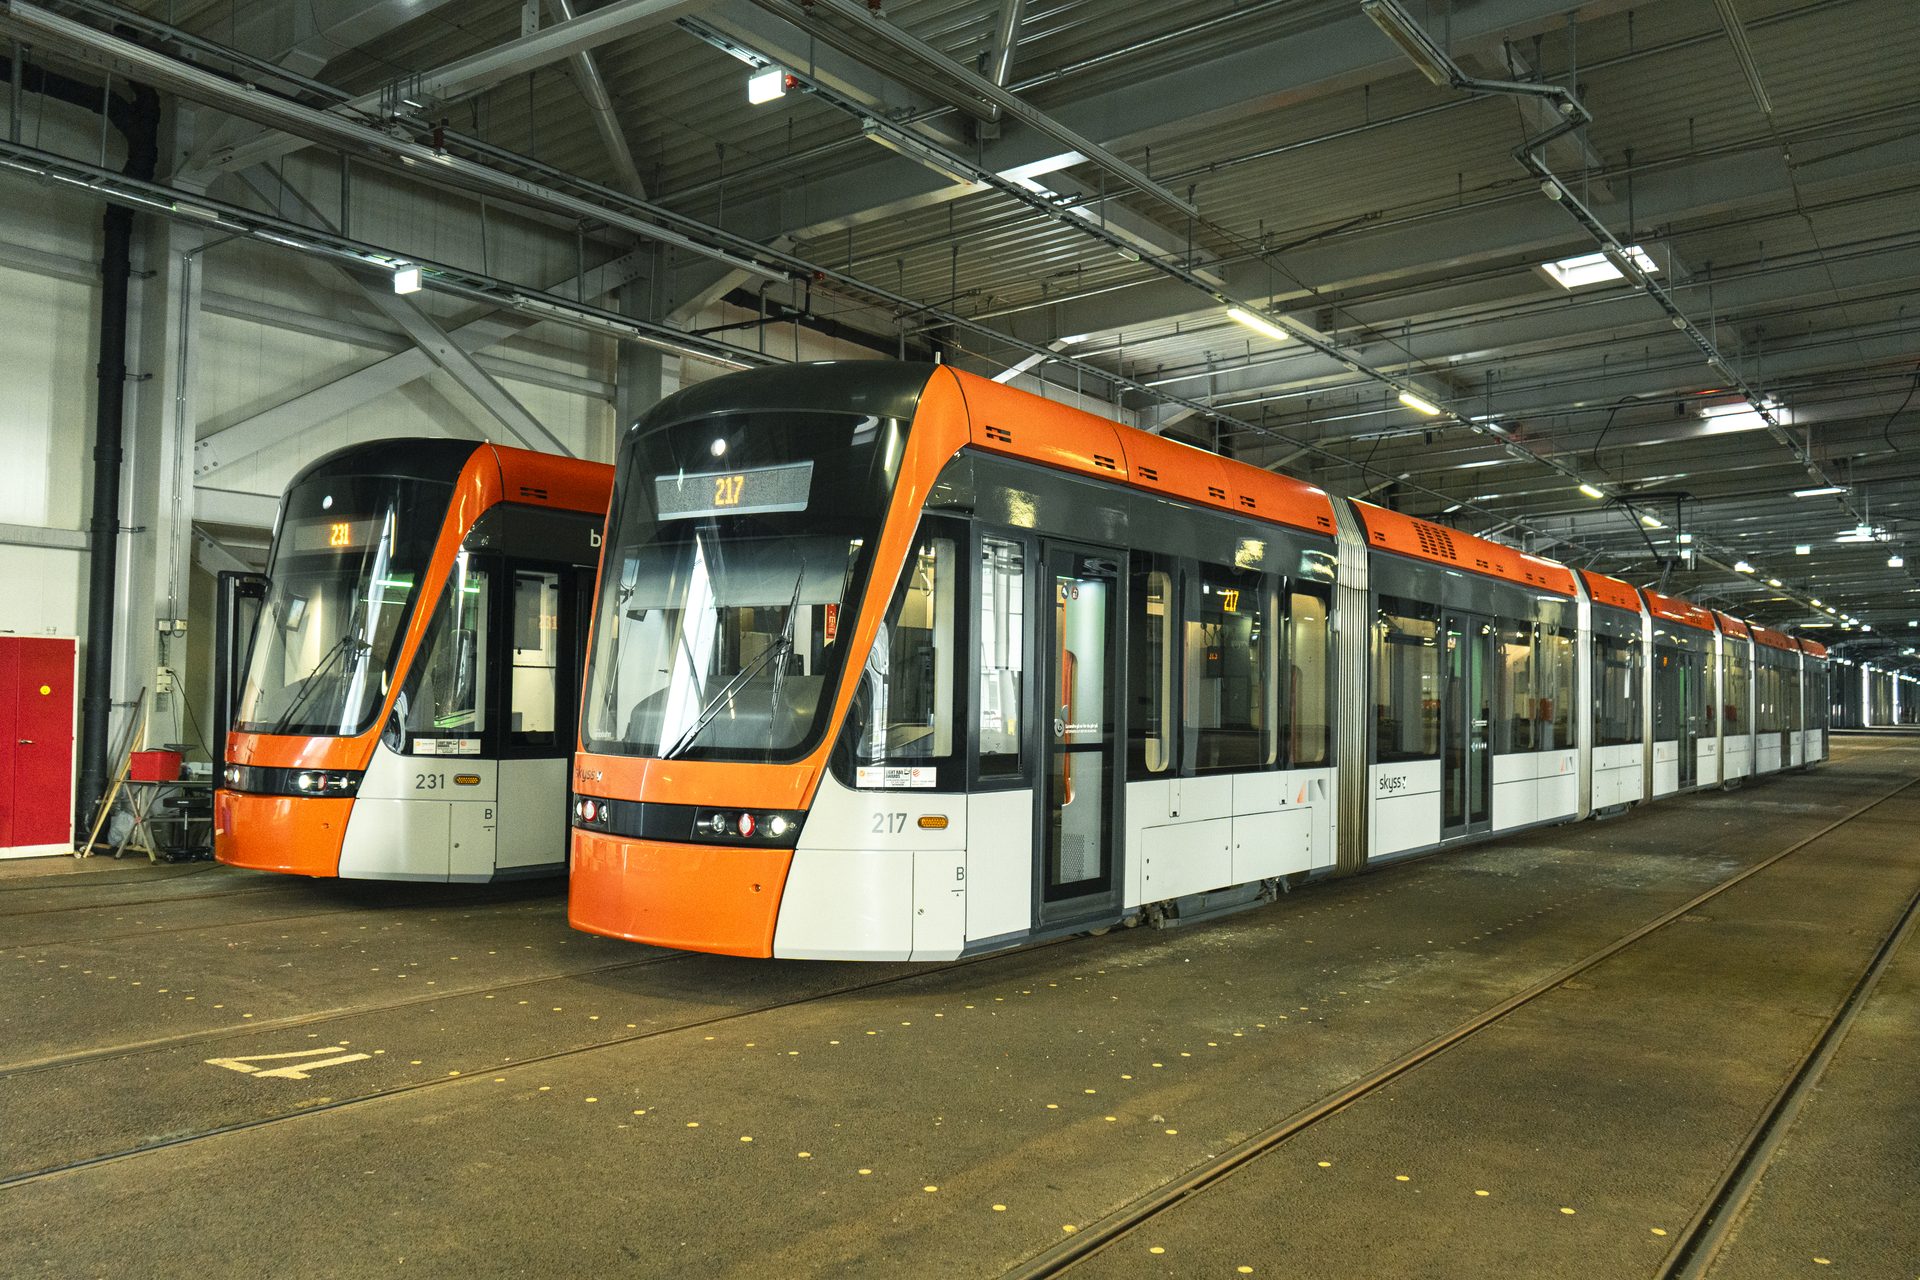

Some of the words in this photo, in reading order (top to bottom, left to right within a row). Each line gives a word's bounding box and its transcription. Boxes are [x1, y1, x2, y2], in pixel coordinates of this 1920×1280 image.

[715, 475, 744, 505] 217
[331, 523, 349, 546] 231
[1223, 588, 1239, 612] 217
[415, 773, 445, 790] 231
[1379, 773, 1401, 793] skyss
[484, 808, 493, 820] B
[871, 812, 908, 834] 217
[956, 866, 965, 881] B
